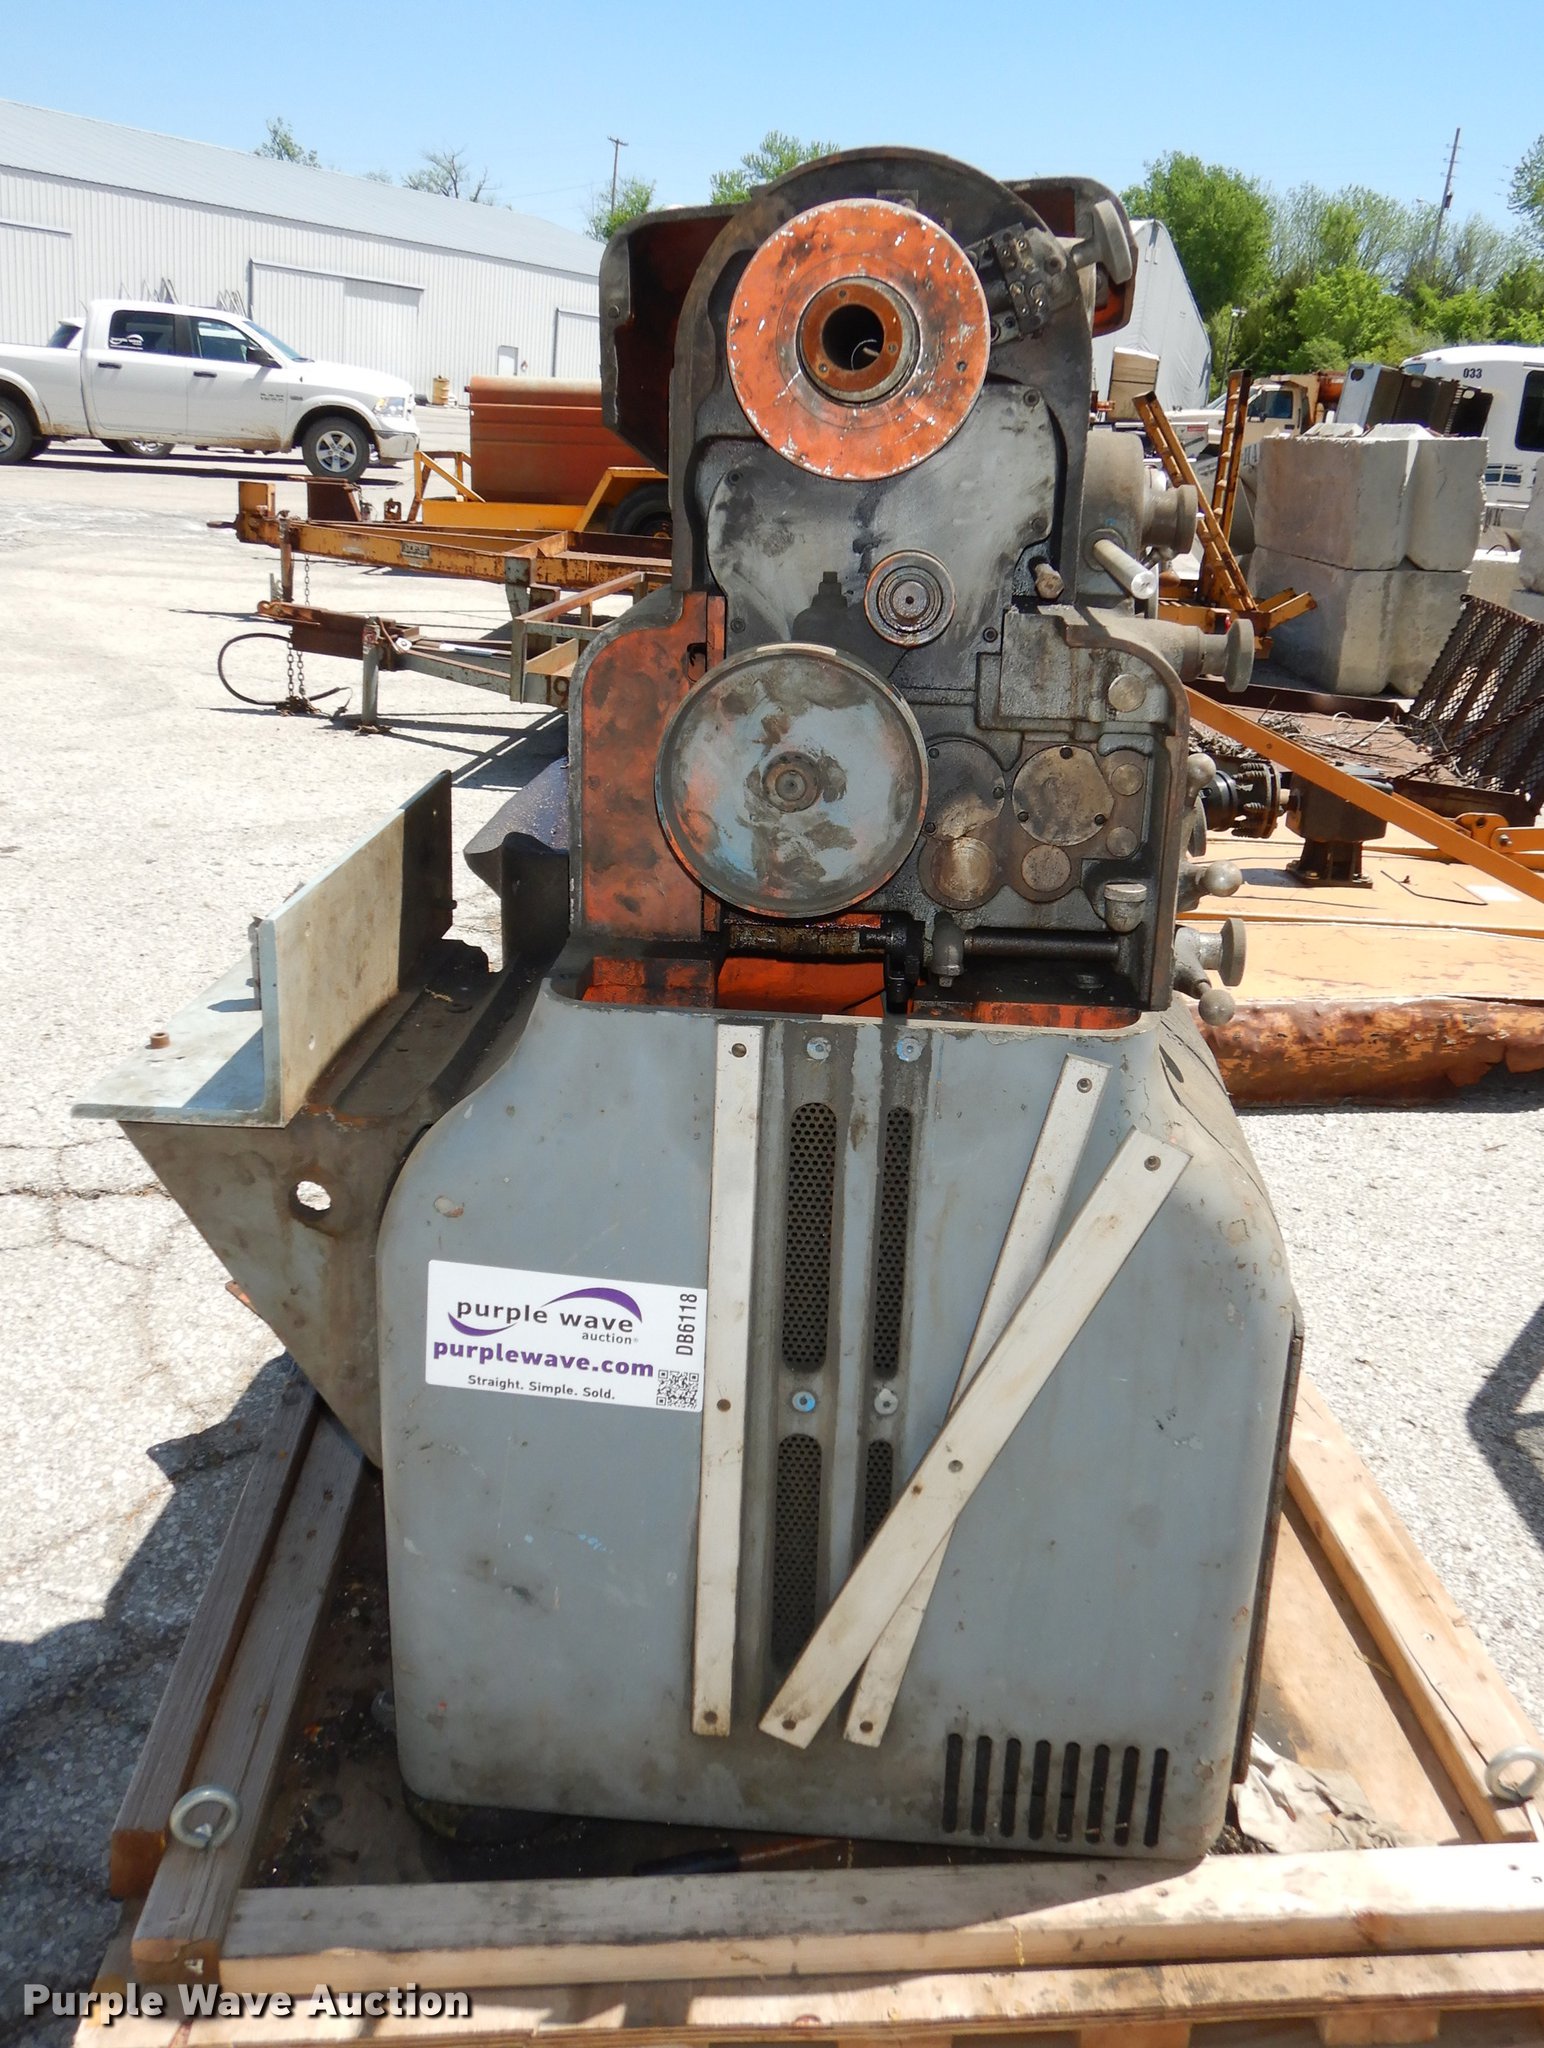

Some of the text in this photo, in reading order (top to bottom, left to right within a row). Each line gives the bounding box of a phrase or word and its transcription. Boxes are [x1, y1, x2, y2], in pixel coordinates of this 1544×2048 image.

[1463, 368, 1483, 379] 033
[457, 1301, 633, 1333] purple wave
[676, 1294, 698, 1356] DB6118
[433, 1341, 654, 1377] purplewave.com
[468, 1375, 615, 1400] Straight. Simple. Sold.
